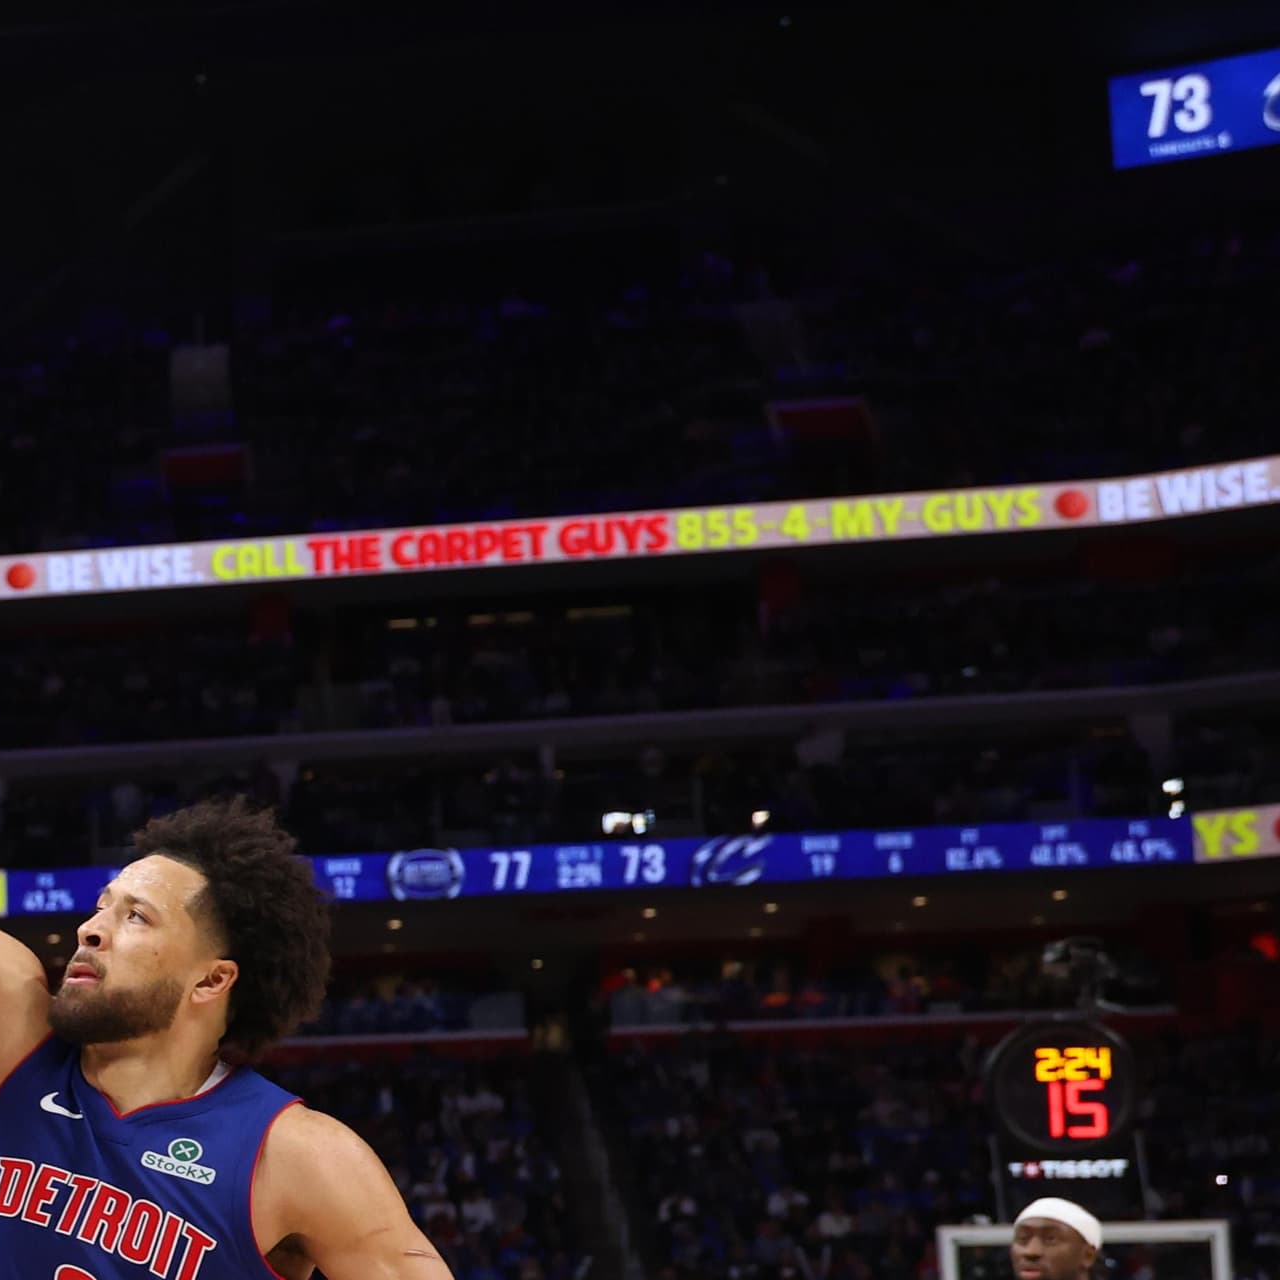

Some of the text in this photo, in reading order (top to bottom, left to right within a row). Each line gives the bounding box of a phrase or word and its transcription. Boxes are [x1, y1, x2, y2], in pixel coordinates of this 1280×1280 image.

[1139, 73, 1212, 138] 73
[46, 554, 92, 592] BE
[98, 547, 205, 590] WISE.
[210, 541, 305, 582] CALL
[306, 532, 383, 576] THE
[389, 521, 549, 571] CARPET
[557, 512, 671, 560] GUYS
[676, 487, 1042, 551] 855-4-MY-GUYS
[1097, 478, 1154, 523] BE
[488, 850, 533, 891] 77
[619, 844, 667, 885] 73
[1047, 1077, 1110, 1139] 15
[144, 1153, 213, 1183] StockX
